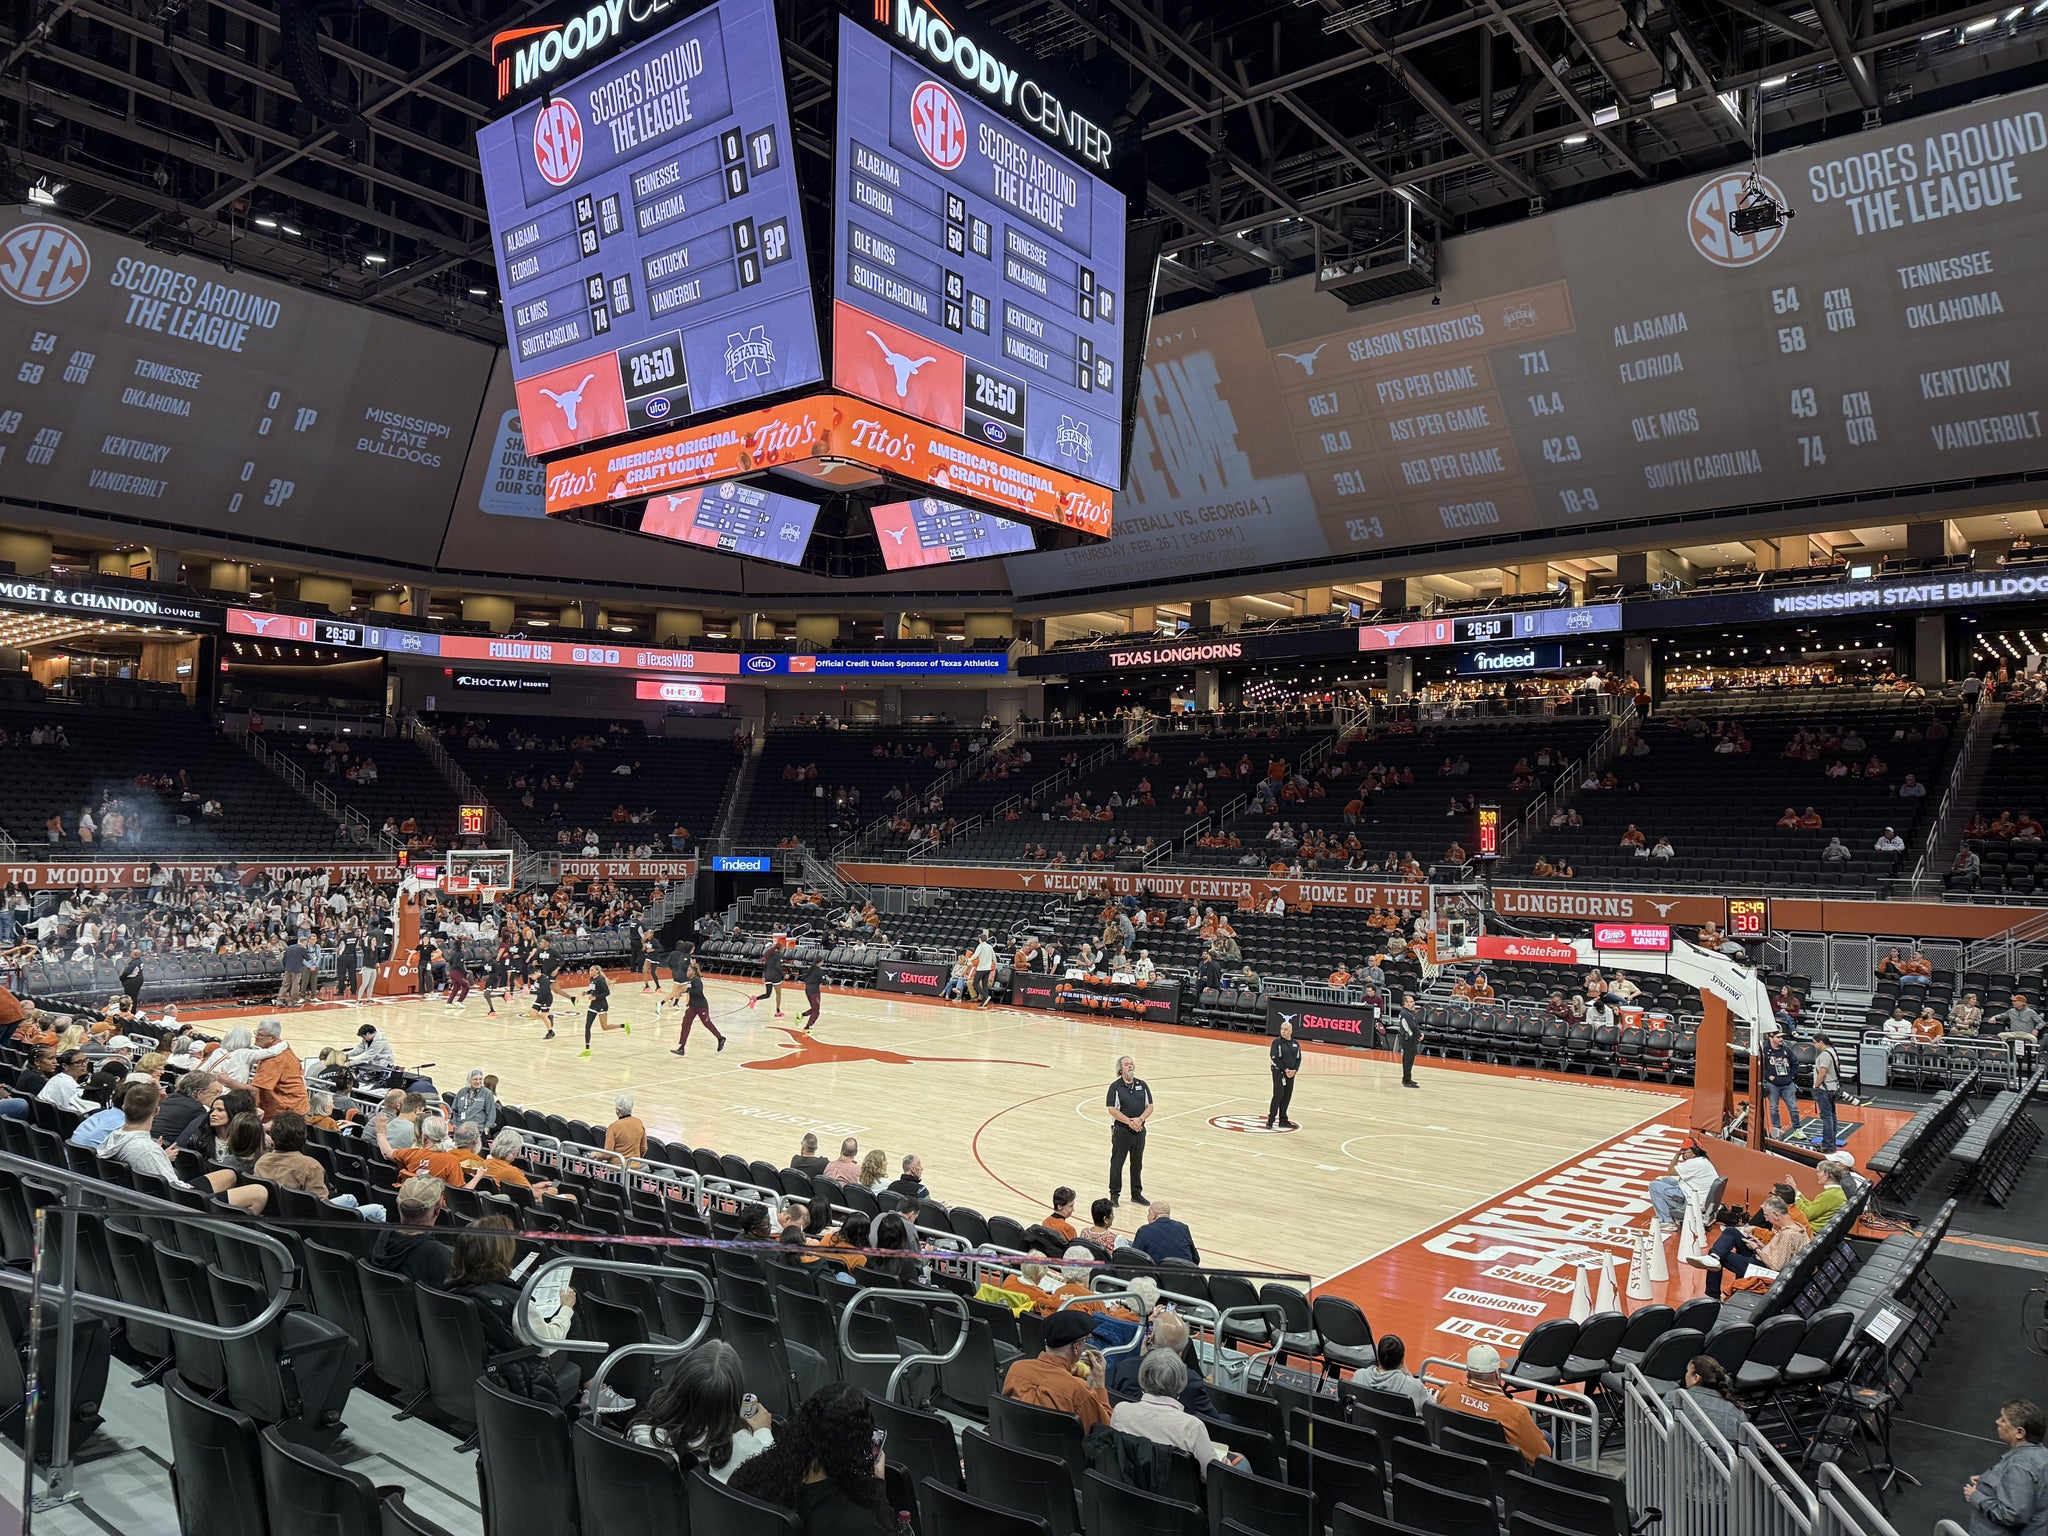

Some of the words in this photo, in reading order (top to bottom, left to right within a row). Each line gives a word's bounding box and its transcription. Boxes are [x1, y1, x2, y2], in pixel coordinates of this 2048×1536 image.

[515, 0, 624, 89] MOODY
[590, 65, 643, 125] SCORES
[645, 38, 703, 97] AROUND
[897, 0, 1018, 106] MOODY
[1019, 80, 1112, 170] CENTER
[609, 116, 638, 154] THE
[638, 85, 692, 144] LEAGUE
[914, 87, 962, 164] SEC
[537, 102, 581, 178] SEC
[752, 134, 772, 169] 1P
[979, 123, 1027, 178] SCORES
[1029, 154, 1077, 209] AROUND
[1808, 143, 1918, 203] SCORES
[1926, 111, 2048, 178] AROUND
[635, 162, 681, 197] TENNESSEE
[578, 200, 591, 221] 54
[601, 198, 616, 219] 4TH
[993, 164, 1016, 207] THE
[1018, 177, 1064, 233] LEAGUE
[1845, 187, 1904, 236] THE
[1904, 161, 2023, 224] LEAGUE
[639, 195, 686, 229] OKLAHOMA
[507, 224, 540, 252] ALABAMA
[582, 230, 597, 253] 58
[603, 215, 619, 234] QTR
[764, 226, 786, 260] 3P
[0, 228, 84, 299] SEC
[511, 257, 540, 282] FLORIDA
[647, 249, 689, 280] KENTUCKY
[1897, 251, 1994, 289] TENNESSEE
[111, 256, 197, 306] SCORES
[198, 280, 280, 330] AROUND
[590, 278, 603, 300] 43
[652, 280, 701, 313] VANDERBILT
[126, 293, 171, 332] THE
[168, 305, 250, 353] LEAGUE
[517, 306, 530, 326] OLE
[530, 301, 548, 322] MISS
[1906, 291, 2005, 329] OKLAHOMA
[522, 335, 545, 357] SOUTH
[546, 322, 580, 349] CAROLINA
[594, 309, 608, 331] 74
[1348, 332, 1402, 362] SEASON
[1403, 314, 1485, 349] STATISTICS
[1613, 312, 1689, 347] ALABAMA
[631, 346, 675, 387] 26:50
[733, 343, 765, 364] STATE
[1518, 350, 1550, 376] 77.1
[134, 359, 202, 389] TENNESSEE
[1620, 352, 1684, 384] FLORIDA
[1920, 360, 2012, 400] KENTUCKY
[976, 373, 1017, 415] 26:50
[1376, 381, 1404, 404] PTS
[1404, 374, 1432, 398] PER
[1434, 365, 1478, 390] GAME
[121, 387, 192, 417] OKLAHOMA
[1308, 392, 1338, 417] 85.7
[1528, 392, 1565, 416] 14.4
[365, 407, 450, 439] MISSISSIPPI
[1389, 418, 1418, 442] AST
[1419, 412, 1446, 436] PER
[1447, 405, 1490, 432] GAME
[1931, 411, 2043, 452] VANDERBILT
[102, 435, 171, 464] KENTUCKY
[380, 428, 428, 449] STATE
[608, 447, 673, 473] AMERICA'S
[675, 430, 739, 457] ORIGINAL
[753, 414, 817, 456] Tito's
[1320, 431, 1352, 453] 18.0
[1542, 435, 1582, 463] 42.9
[355, 438, 441, 467] BULLDOGS
[499, 468, 514, 480] TO
[518, 470, 533, 481] BE
[626, 463, 666, 484] CRAFT
[1401, 460, 1431, 485] REB
[1431, 454, 1461, 480] PER
[1462, 448, 1505, 475] GAME
[88, 470, 168, 499] VANDERBILT
[496, 481, 523, 494] OUR
[548, 467, 597, 502] Tito's
[1333, 471, 1365, 496] 39.1
[1176, 510, 1197, 526] VS.
[1199, 500, 1260, 524] GEORGIA
[1559, 487, 1599, 513] 18-9
[1439, 500, 1499, 529] RECORD
[1346, 517, 1384, 541] 25-3
[0, 583, 50, 601] MOËT
[54, 589, 67, 603] &
[71, 591, 157, 615] CHANDON
[158, 607, 200, 618] LOUNGE
[1774, 590, 1879, 613] MISSISSIPPI
[1883, 584, 1944, 603] STATE
[299, 621, 308, 636] 0
[326, 626, 355, 641] 26:50
[371, 630, 378, 644] 0
[1435, 624, 1444, 640] 0
[1467, 620, 1501, 635] 26:50
[1524, 616, 1533, 632] 0
[489, 642, 530, 659] FOLLOW
[532, 645, 552, 660] US!
[637, 652, 694, 668] @TexasWBB
[752, 659, 771, 669] ufcu
[1110, 651, 1150, 667] TEXAS
[1154, 643, 1242, 663] LONGHORNS
[1475, 652, 1534, 670] indeed
[816, 660, 843, 668] Official
[846, 660, 869, 668] Credit
[871, 660, 894, 668] Union
[896, 660, 928, 670] Sponsor
[930, 660, 939, 668] of
[941, 660, 961, 668] Texas
[964, 660, 999, 668] Athletics
[463, 677, 517, 688] CHOCTAW
[464, 817, 480, 831] 30
[8, 868, 36, 884] TO
[46, 868, 124, 884] MOODY
[561, 863, 600, 878] HOOK
[605, 863, 634, 878] 'EM,
[639, 862, 687, 877] HORNS
[721, 859, 761, 871] indeed
[1044, 874, 1107, 890] WELCOME
[1112, 878, 1130, 893] TO
[1191, 881, 1252, 897] CENTER
[1299, 884, 1348, 902] HOME
[1355, 887, 1377, 903] OF
[1386, 887, 1422, 907] THE
[1504, 894, 1633, 917] LONGHORNS
[1730, 901, 1765, 915] 26:49
[1631, 929, 1668, 938] RAISING
[1737, 915, 1759, 931] 30
[1633, 938, 1665, 946] CANE'S
[900, 972, 938, 986] SEATGEEK
[1026, 987, 1051, 997] SEATGEEK
[1710, 974, 1741, 1001] SPALDING
[1144, 1000, 1171, 1009] SEATGEEK
[1303, 1014, 1362, 1034] SEATGEEK
[1492, 1268, 1572, 1290] HORNS
[1631, 1249, 1641, 1290] TEXAS
[1449, 1291, 1539, 1314] LONGHORNS
[1461, 1394, 1489, 1412] TEXAS
